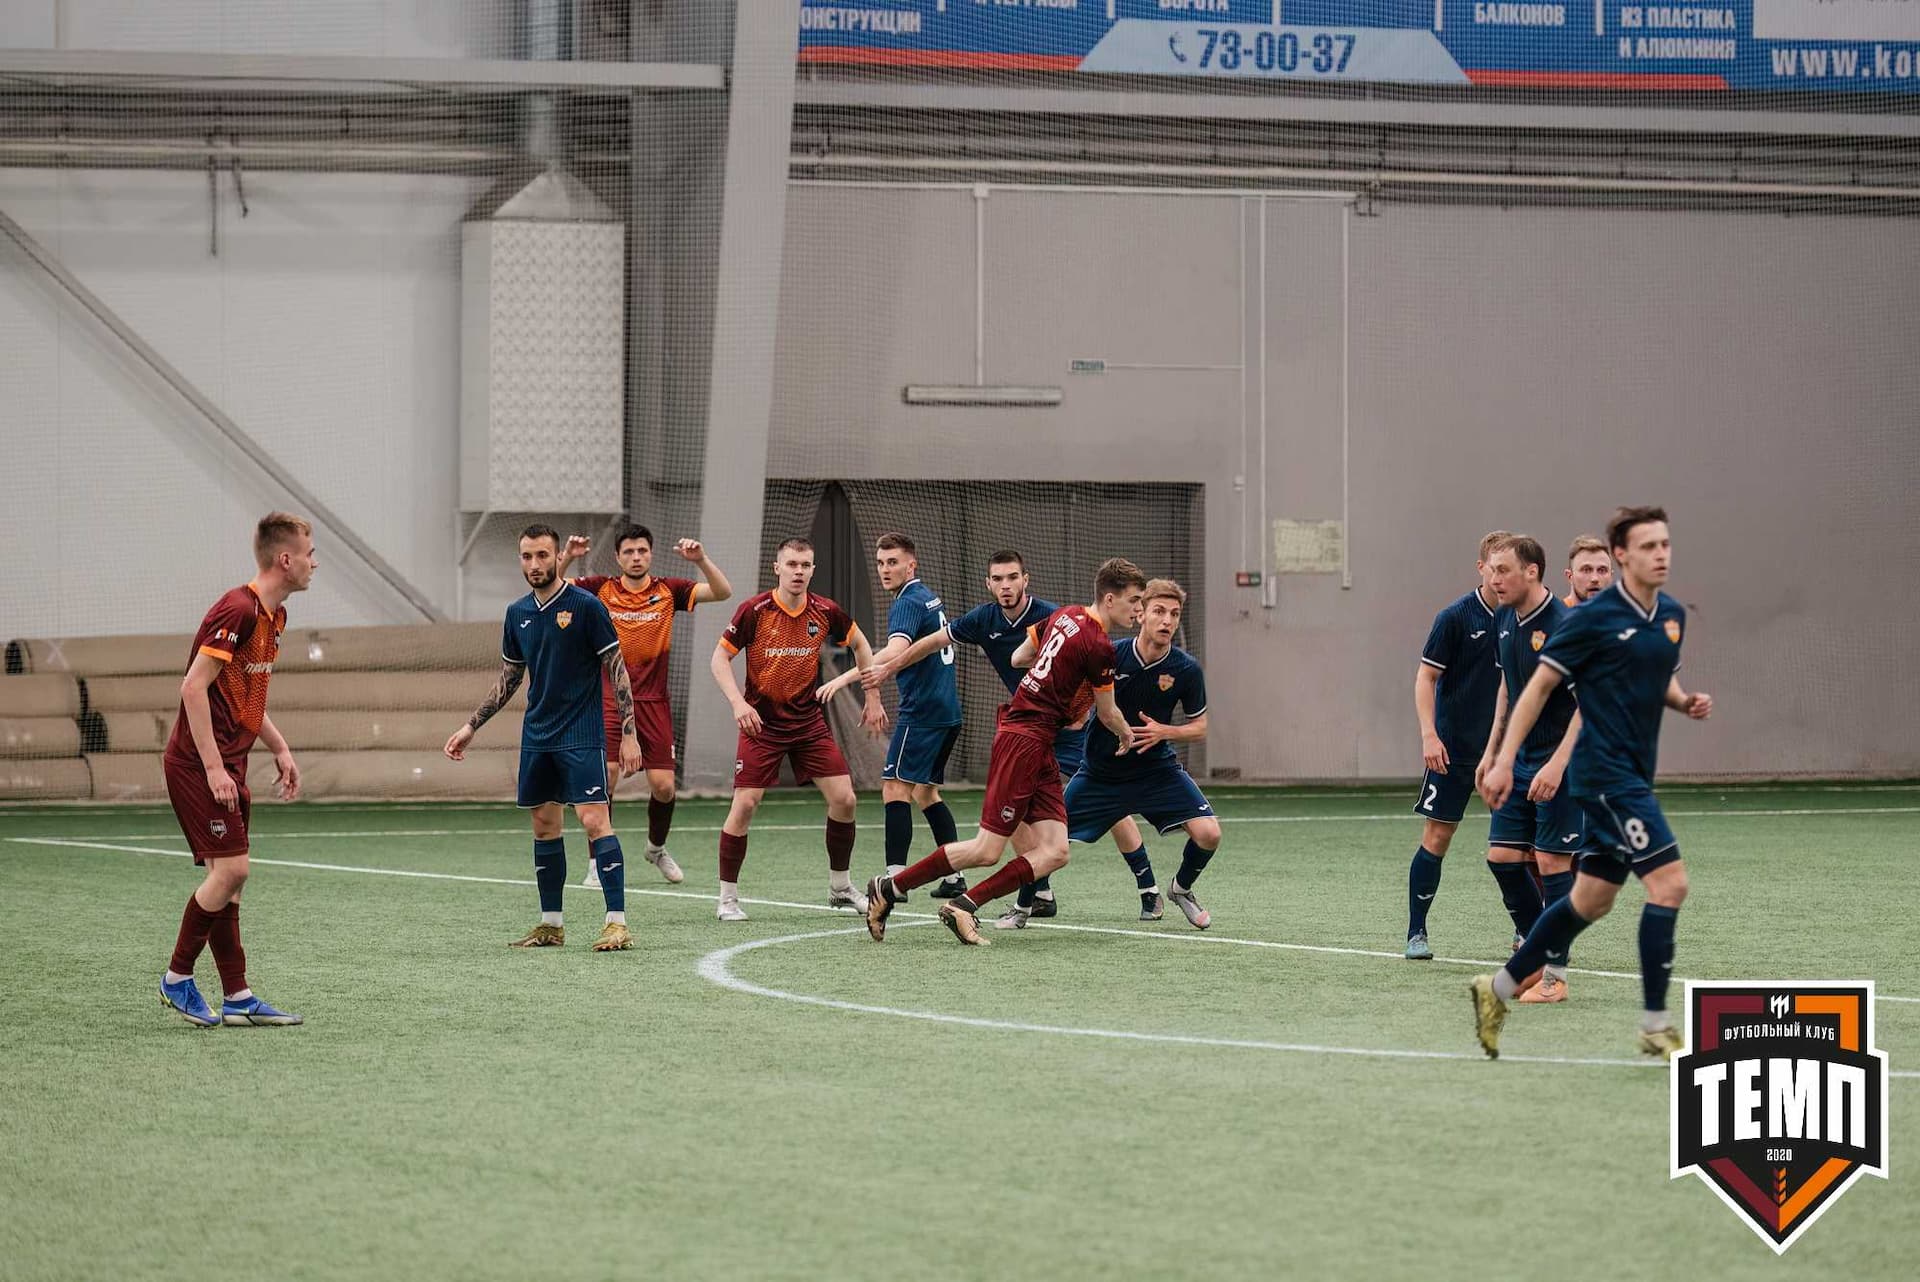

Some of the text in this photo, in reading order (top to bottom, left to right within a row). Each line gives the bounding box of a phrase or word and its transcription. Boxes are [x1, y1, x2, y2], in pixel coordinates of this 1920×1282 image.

[1475, 3, 1565, 26] БАЛКОНОВ
[1621, 7, 1735, 29] ИЗ ПЛАСТИКА
[1197, 30, 1356, 73] 73-00-37
[1619, 38, 1735, 59] И АЛЮМИНИЯ
[1423, 784, 1437, 811] 2
[1624, 817, 1649, 851] 8
